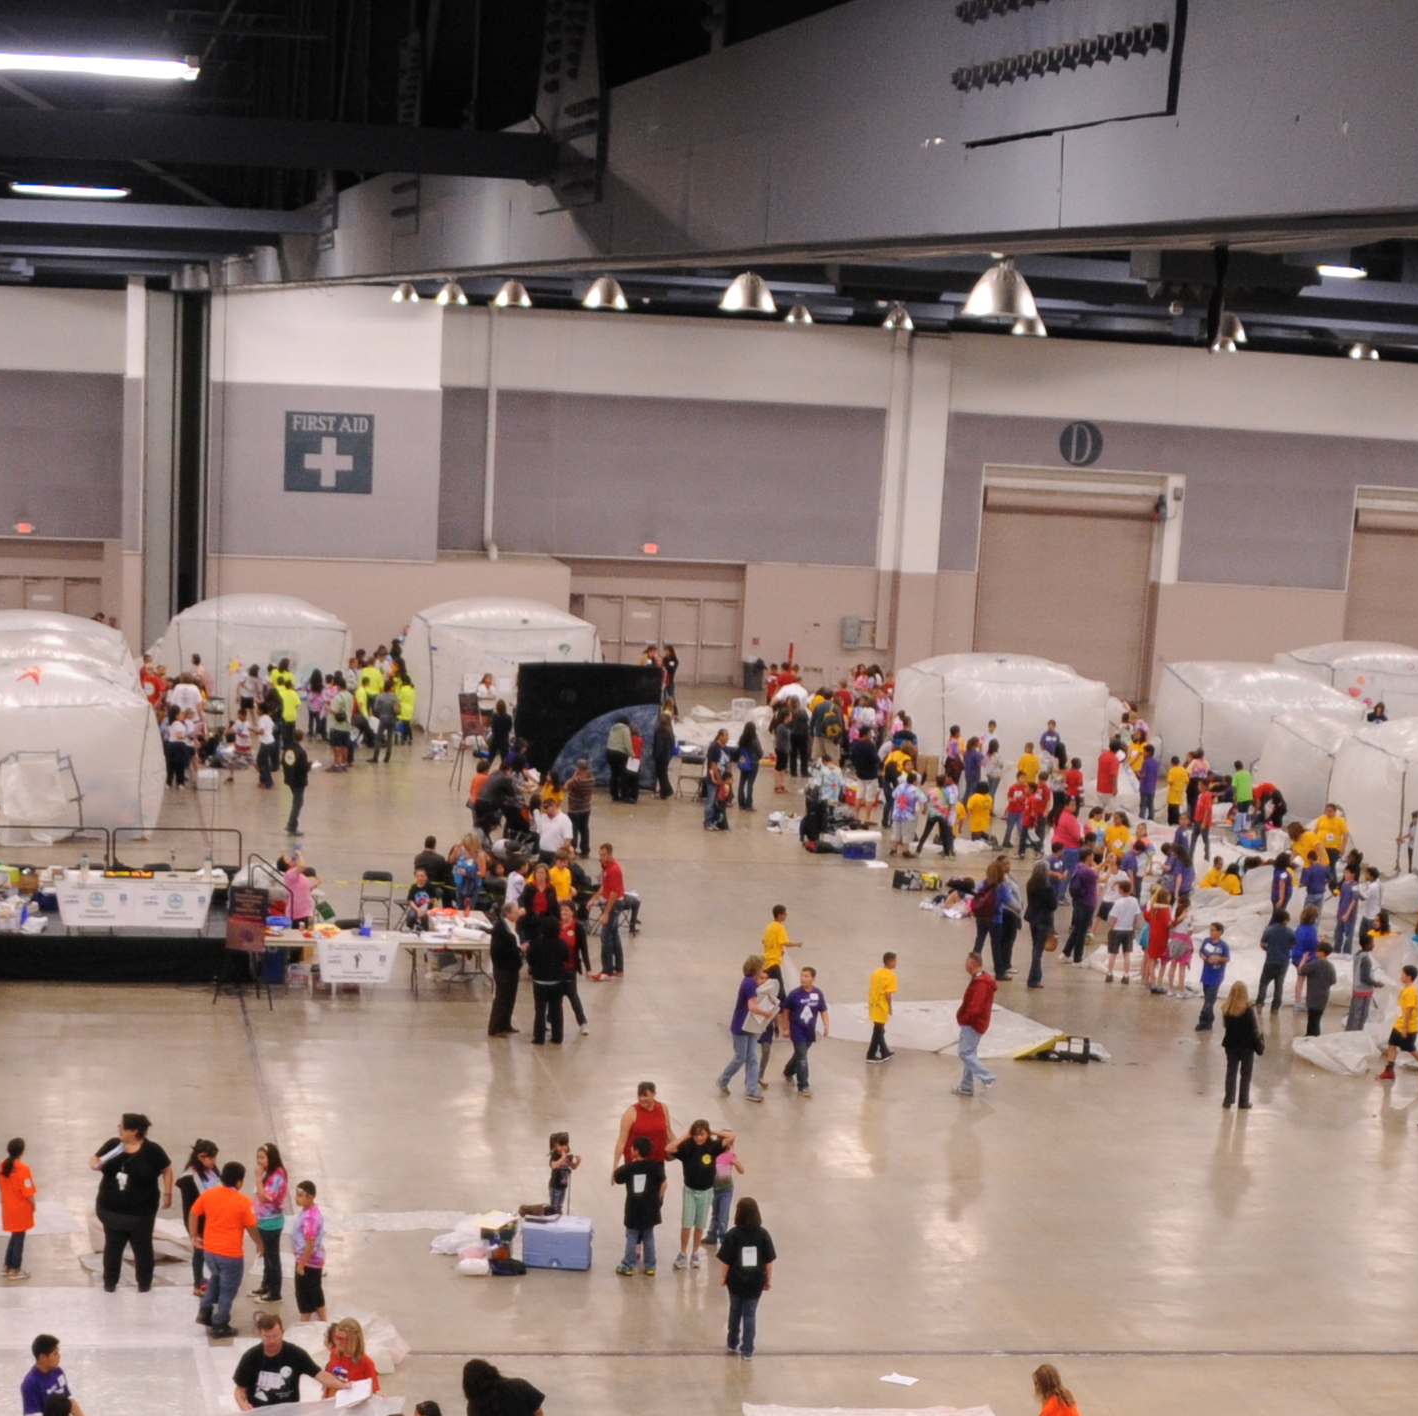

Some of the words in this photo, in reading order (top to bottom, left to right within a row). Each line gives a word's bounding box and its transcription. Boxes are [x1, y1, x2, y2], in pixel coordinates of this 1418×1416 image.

[293, 415, 336, 431] FIRST
[339, 416, 368, 432] AID
[1070, 424, 1093, 463] D
